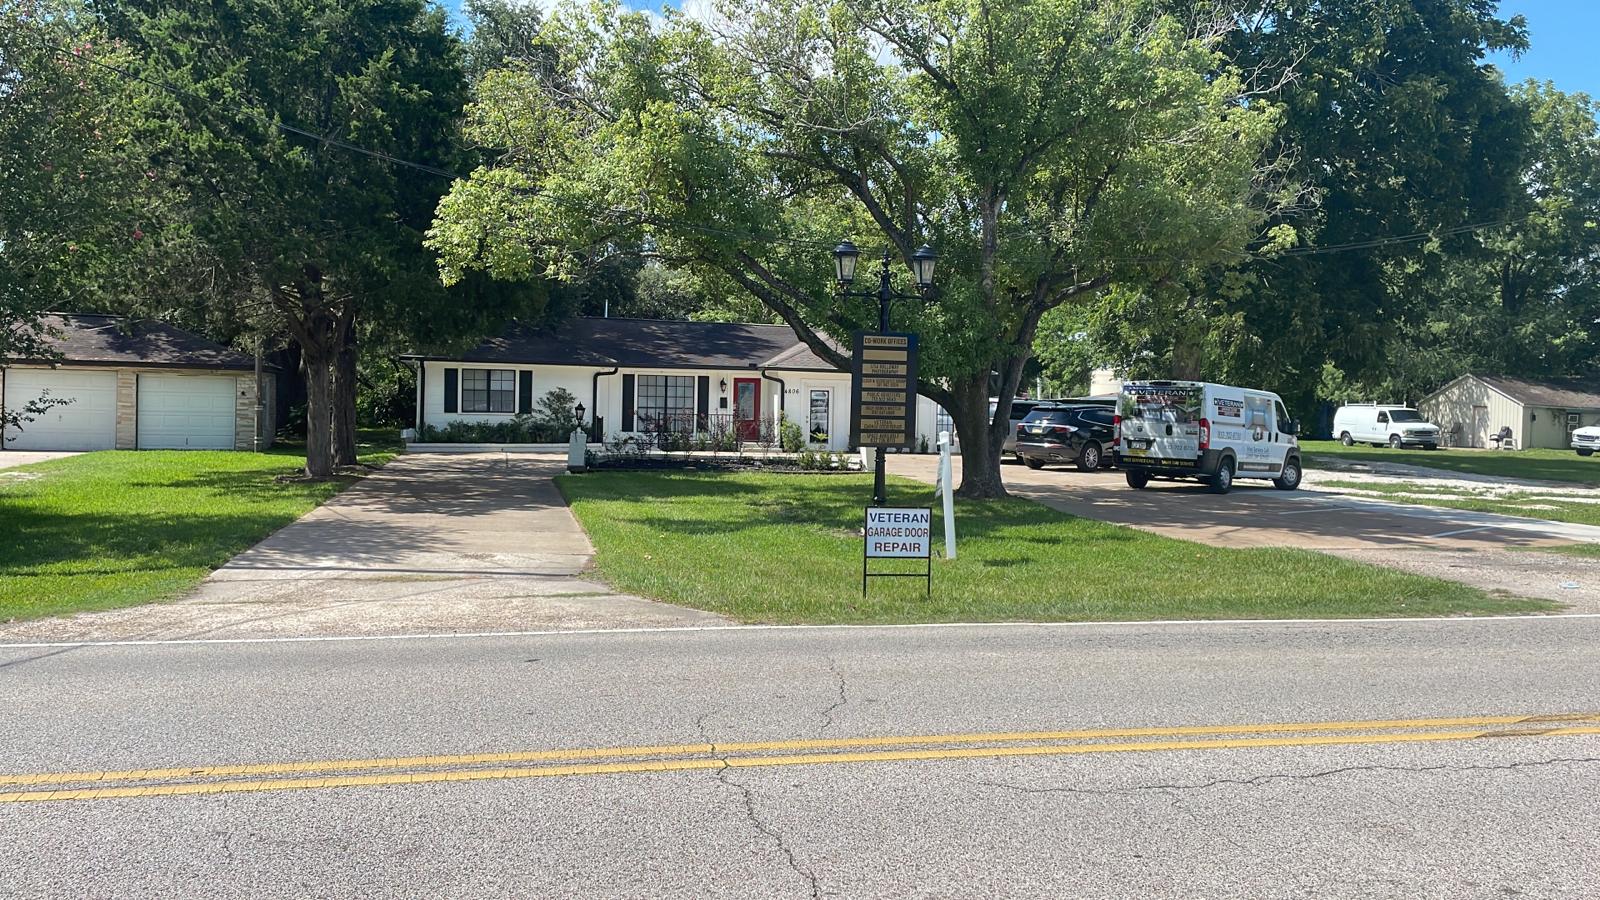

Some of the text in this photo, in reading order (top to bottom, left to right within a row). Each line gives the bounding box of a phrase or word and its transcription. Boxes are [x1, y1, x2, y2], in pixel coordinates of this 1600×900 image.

[1218, 399, 1240, 407] VETERAN
[870, 512, 928, 523] VETERAN
[868, 527, 928, 538] GARAGE DOOR
[874, 542, 921, 552] REPAIR
